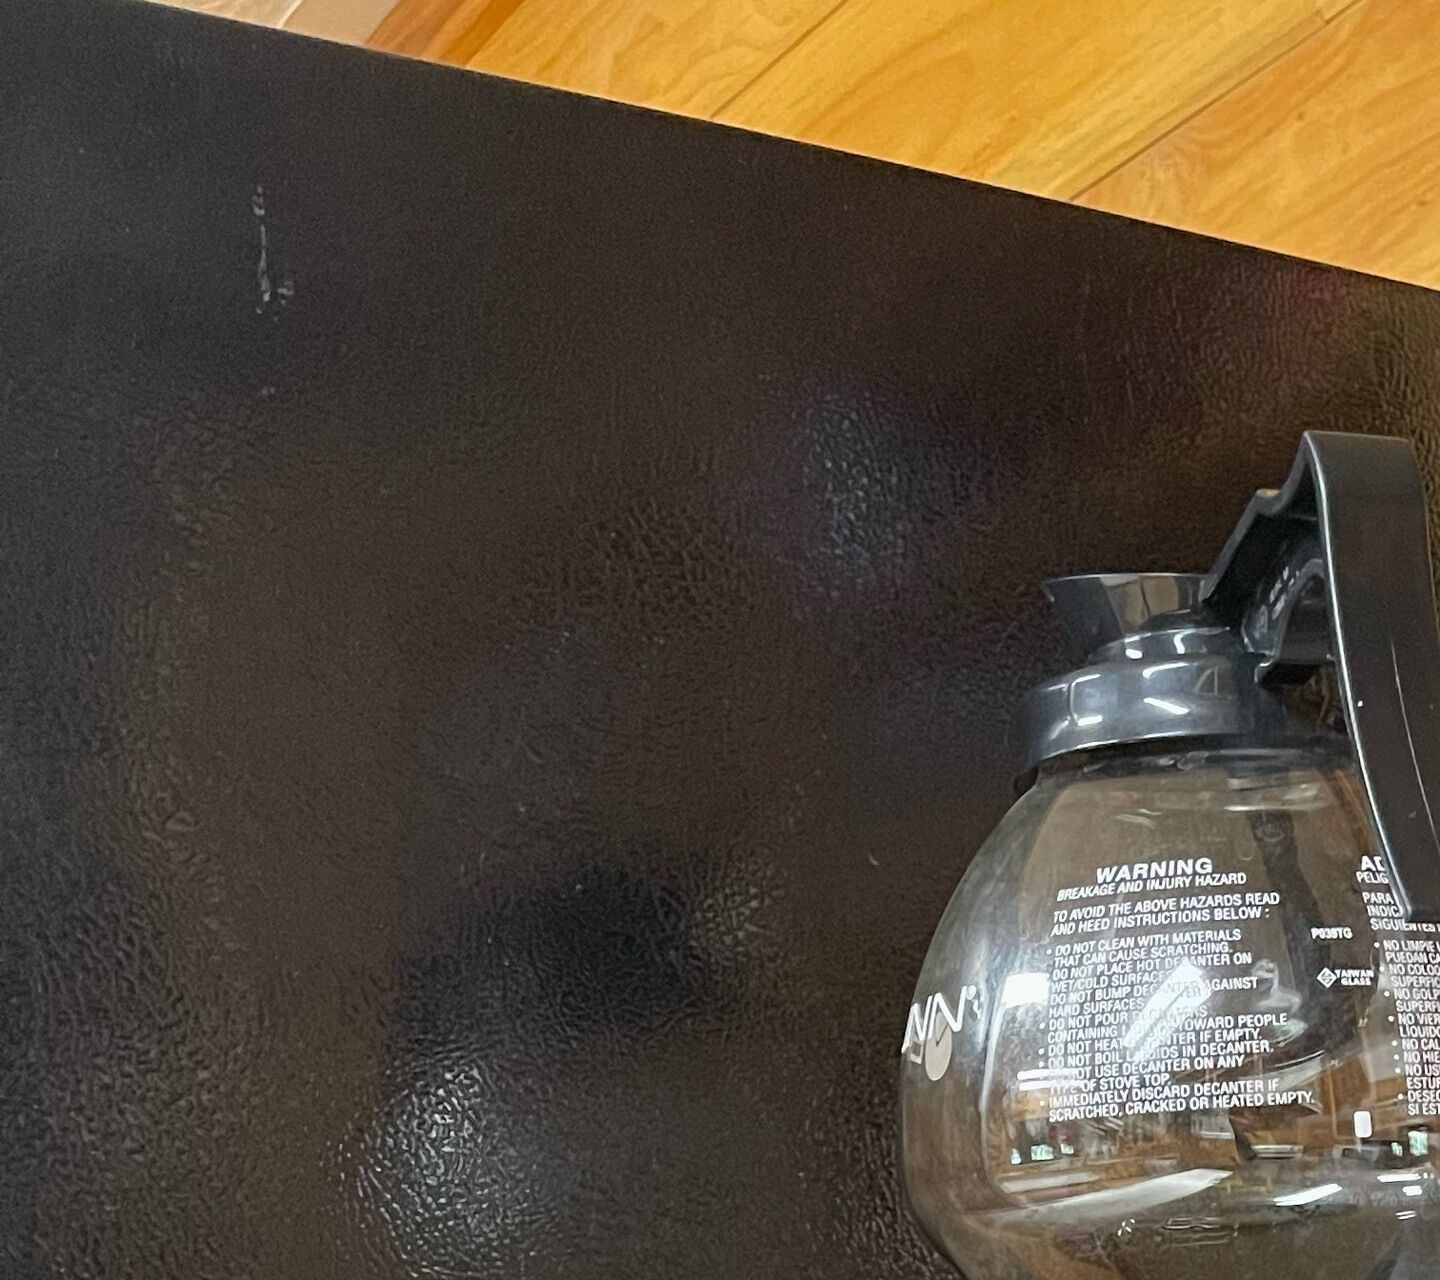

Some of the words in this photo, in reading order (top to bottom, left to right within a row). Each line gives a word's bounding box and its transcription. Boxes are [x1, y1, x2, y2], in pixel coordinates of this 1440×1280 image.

[1096, 856, 1212, 883] WARNING
[1057, 884, 1114, 900] BREAKAGE
[1117, 881, 1142, 894] AND
[1146, 876, 1191, 892] INJURY
[1195, 872, 1246, 887] HAZARD
[1054, 909, 1066, 922] TO
[1070, 905, 1104, 919] AVOID
[1109, 903, 1130, 916] THE
[1133, 899, 1176, 914] ABOVE
[1180, 893, 1241, 910] HAZARDS
[1245, 891, 1279, 906] READ
[1362, 892, 1394, 904] PARA
[1051, 922, 1074, 936] AND
[1078, 918, 1109, 933] HEED
[1114, 910, 1210, 930] INSTRUCTIONS
[1056, 943, 1070, 956] DO
[1074, 941, 1094, 954] NOT
[1098, 937, 1133, 952] CLEAN
[1137, 934, 1168, 948] WITH
[1172, 927, 1241, 945] MATERIALS
[1383, 938, 1399, 951] NO
[1054, 954, 1078, 968] THAT
[1082, 951, 1106, 965] CAN
[1109, 947, 1146, 962] CAUSE
[1150, 940, 1232, 959] SCRATCHING.
[1386, 951, 1427, 964] PUEDAN
[1053, 967, 1067, 981] DO
[1070, 964, 1093, 978] NOT
[1096, 961, 1131, 976] PLACE
[1136, 958, 1161, 972] HOT
[1233, 951, 1251, 965] ON
[1334, 969, 1374, 978] TAIWAN
[1389, 963, 1405, 975] NO
[1340, 977, 1371, 986] GLASS
[1051, 992, 1065, 1006] DO
[1068, 989, 1091, 1003] NOT
[1095, 985, 1133, 1001] BUMP
[1394, 988, 1409, 999] NO
[1049, 1003, 1079, 1018] HARD
[1399, 1013, 1414, 1024] NO
[1048, 1025, 1117, 1042] CONTAINING
[1238, 1011, 1288, 1028] PEOPLE
[1050, 1017, 1064, 1031] DO
[1068, 1014, 1090, 1028] NOT
[1094, 1011, 1127, 1026] POUR
[1048, 1043, 1064, 1057] DO
[1067, 1040, 1089, 1054] NOT
[1199, 1030, 1211, 1043] IF
[1214, 1026, 1261, 1042] EMPTY.
[1402, 1038, 1418, 1049] NO
[1048, 1055, 1064, 1069] DO
[1067, 1053, 1091, 1066] NOT
[1094, 1050, 1122, 1064] BOIL
[1182, 1044, 1195, 1057] IN
[1200, 1039, 1273, 1056] DECANTER.
[1404, 1051, 1420, 1062] NO
[1095, 1063, 1118, 1077] USE
[1122, 1057, 1189, 1075] DECANTER
[1194, 1056, 1213, 1070] ON
[1216, 1054, 1244, 1068] ANY
[1405, 1064, 1421, 1076] NO
[1049, 1089, 1128, 1108] IMMEDIATELY
[1132, 1084, 1190, 1101] DISCARD
[1193, 1078, 1263, 1096] DECANTER
[1268, 1078, 1279, 1091] IF
[1081, 1078, 1096, 1091] OF
[1100, 1075, 1139, 1089] STOVE
[1049, 1103, 1122, 1121] SCRATCHED,
[1125, 1098, 1185, 1116] CRACKED
[1189, 1097, 1208, 1111] OR
[1213, 1093, 1263, 1109] HEATED
[1267, 1089, 1315, 1106] EMPTY.
[1408, 1103, 1418, 1115] SI
